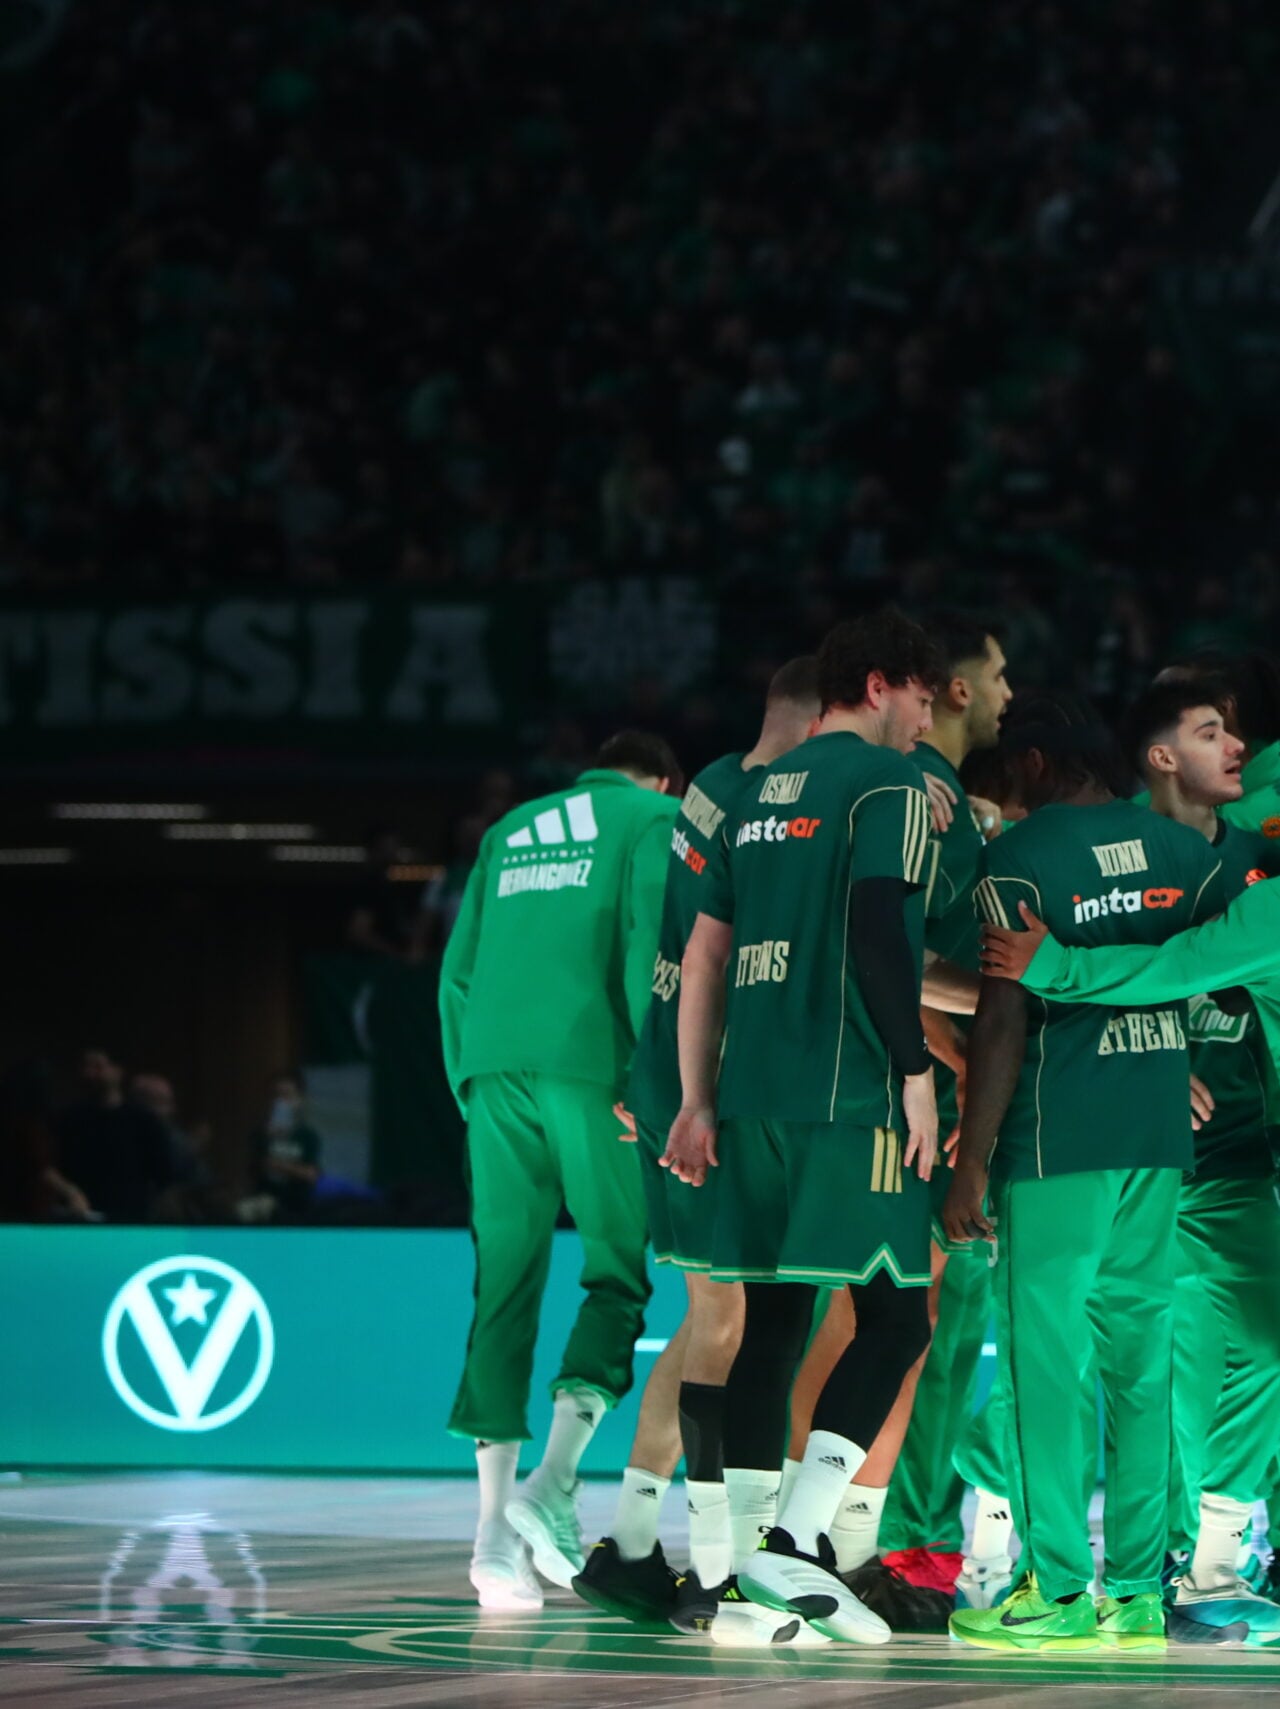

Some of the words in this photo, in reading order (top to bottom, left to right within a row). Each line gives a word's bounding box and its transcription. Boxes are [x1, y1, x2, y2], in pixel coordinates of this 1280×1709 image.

[1091, 839, 1148, 877] NUNN
[1072, 887, 1184, 925] instacar
[1098, 1010, 1186, 1056] ATHENS
